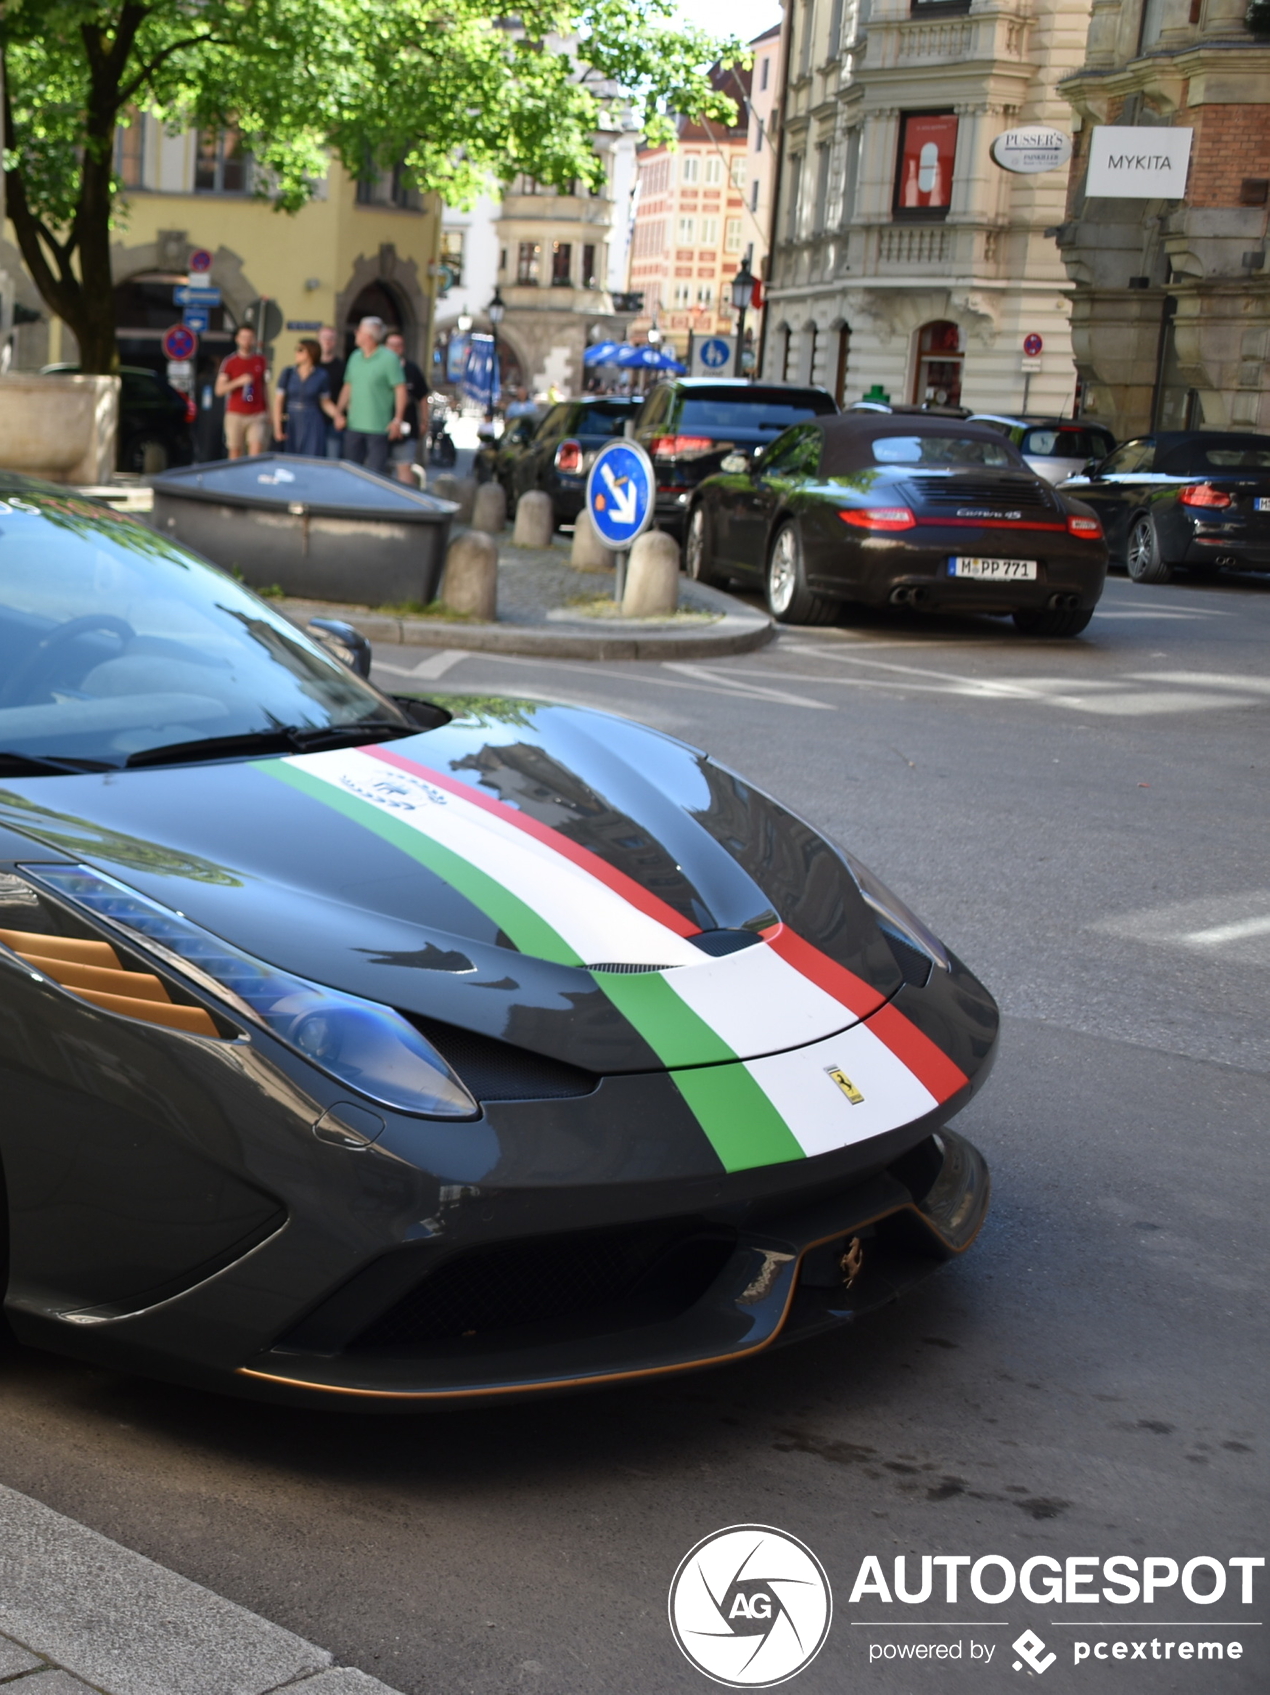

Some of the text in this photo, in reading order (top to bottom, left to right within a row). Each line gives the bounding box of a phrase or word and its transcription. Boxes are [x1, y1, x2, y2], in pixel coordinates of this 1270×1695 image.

[1005, 132, 1063, 147] PUSSER'S
[1107, 154, 1172, 170] MYKITA
[961, 560, 1029, 577] M PP 771
